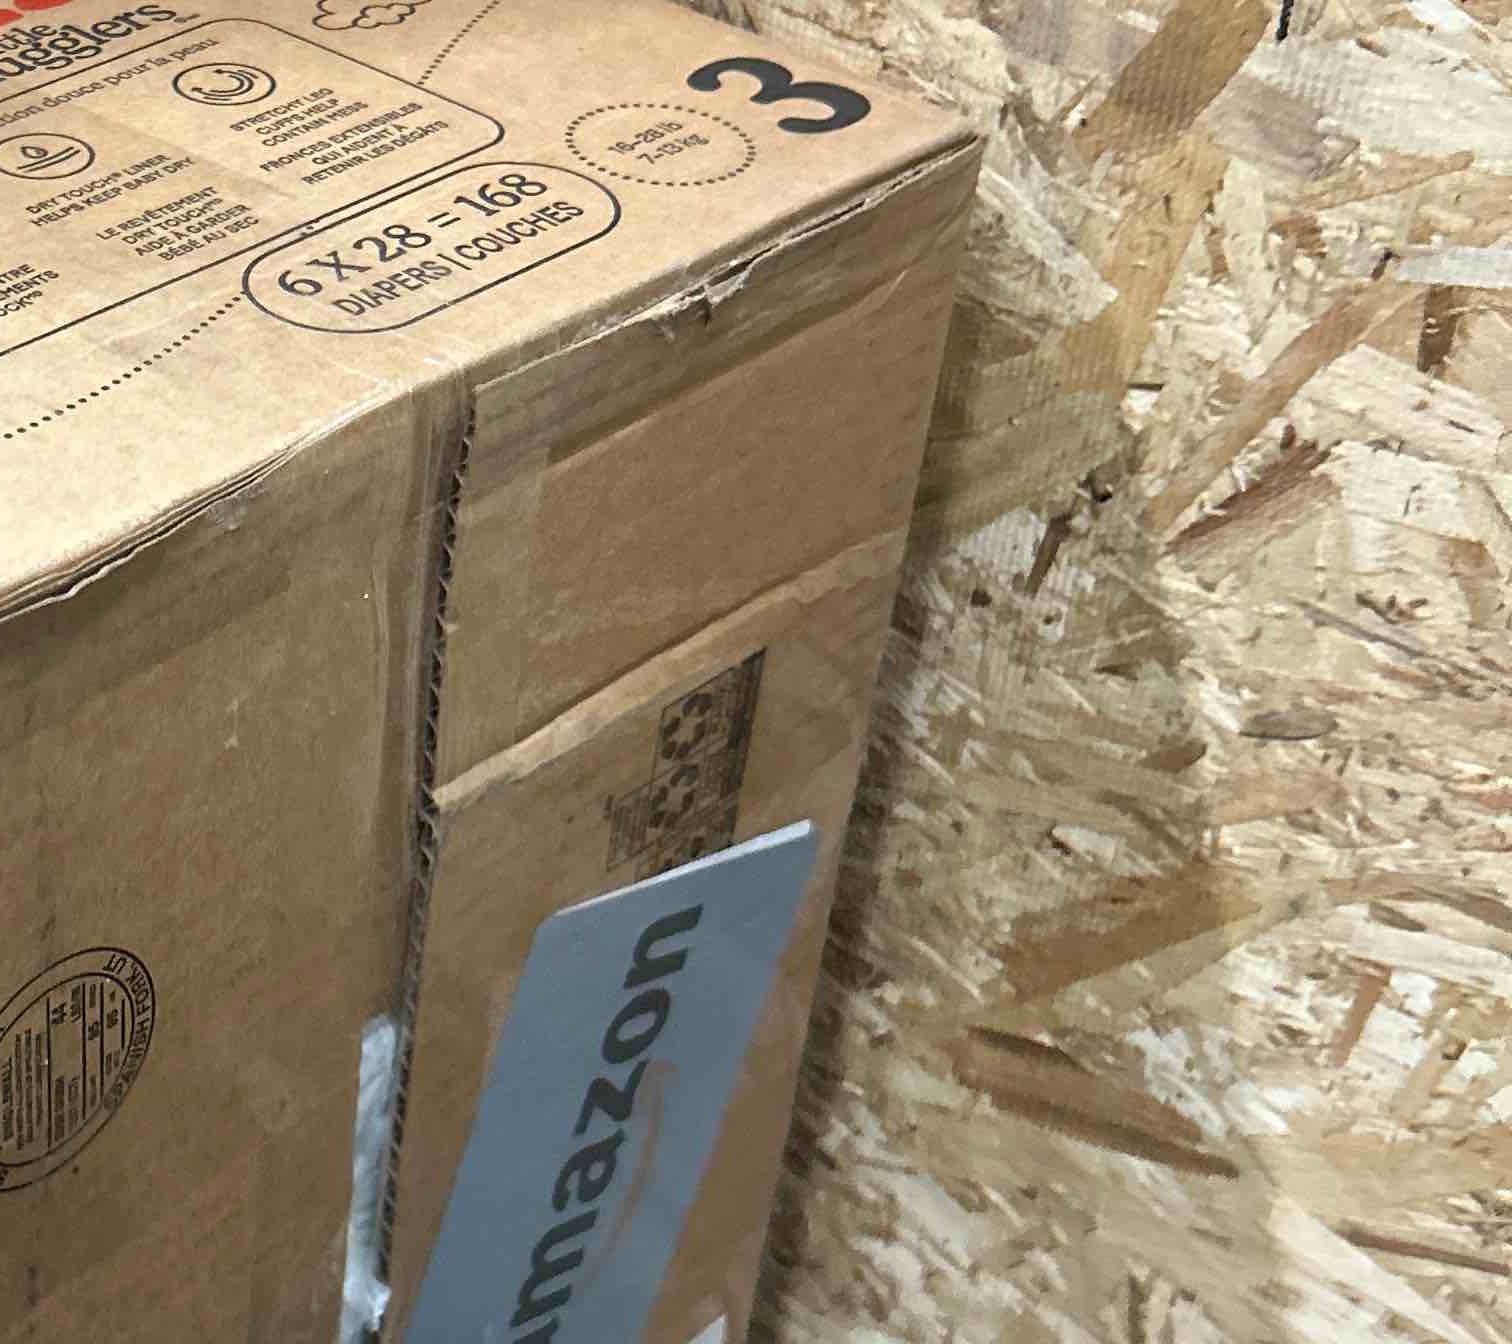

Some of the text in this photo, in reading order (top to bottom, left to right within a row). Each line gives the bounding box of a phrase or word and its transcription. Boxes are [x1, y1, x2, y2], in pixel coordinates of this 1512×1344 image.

[41, 81, 106, 108] douce
[101, 63, 152, 86] pour
[151, 56, 172, 68] la
[167, 38, 220, 62] peau
[686, 56, 872, 134] 3
[229, 87, 335, 132] STRETCHY LEG
[255, 98, 339, 135] CUFFS HELP
[261, 117, 331, 147] CONTAIN
[259, 102, 424, 172] FRONCES EXTENSIBLES
[300, 155, 369, 185] RETENIR
[363, 143, 396, 159] LES
[311, 150, 345, 165] QUI
[340, 127, 402, 155] AIDENT
[25, 197, 60, 215] DRY
[122, 154, 171, 176] LINER
[29, 156, 195, 227] HELPS KEEP BABY DRY
[95, 186, 218, 241] LE REVÊTEMENT
[121, 227, 156, 245] DRY
[134, 235, 176, 257] AIDE
[185, 204, 252, 234] GARDER
[157, 216, 260, 262] BÉBÉ AU SEC
[277, 269, 324, 297] 6
[304, 250, 373, 282] X
[352, 224, 432, 263] 28
[453, 173, 548, 217] 168
[330, 260, 453, 316] DIAPERS
[453, 201, 585, 261] COUCHES
